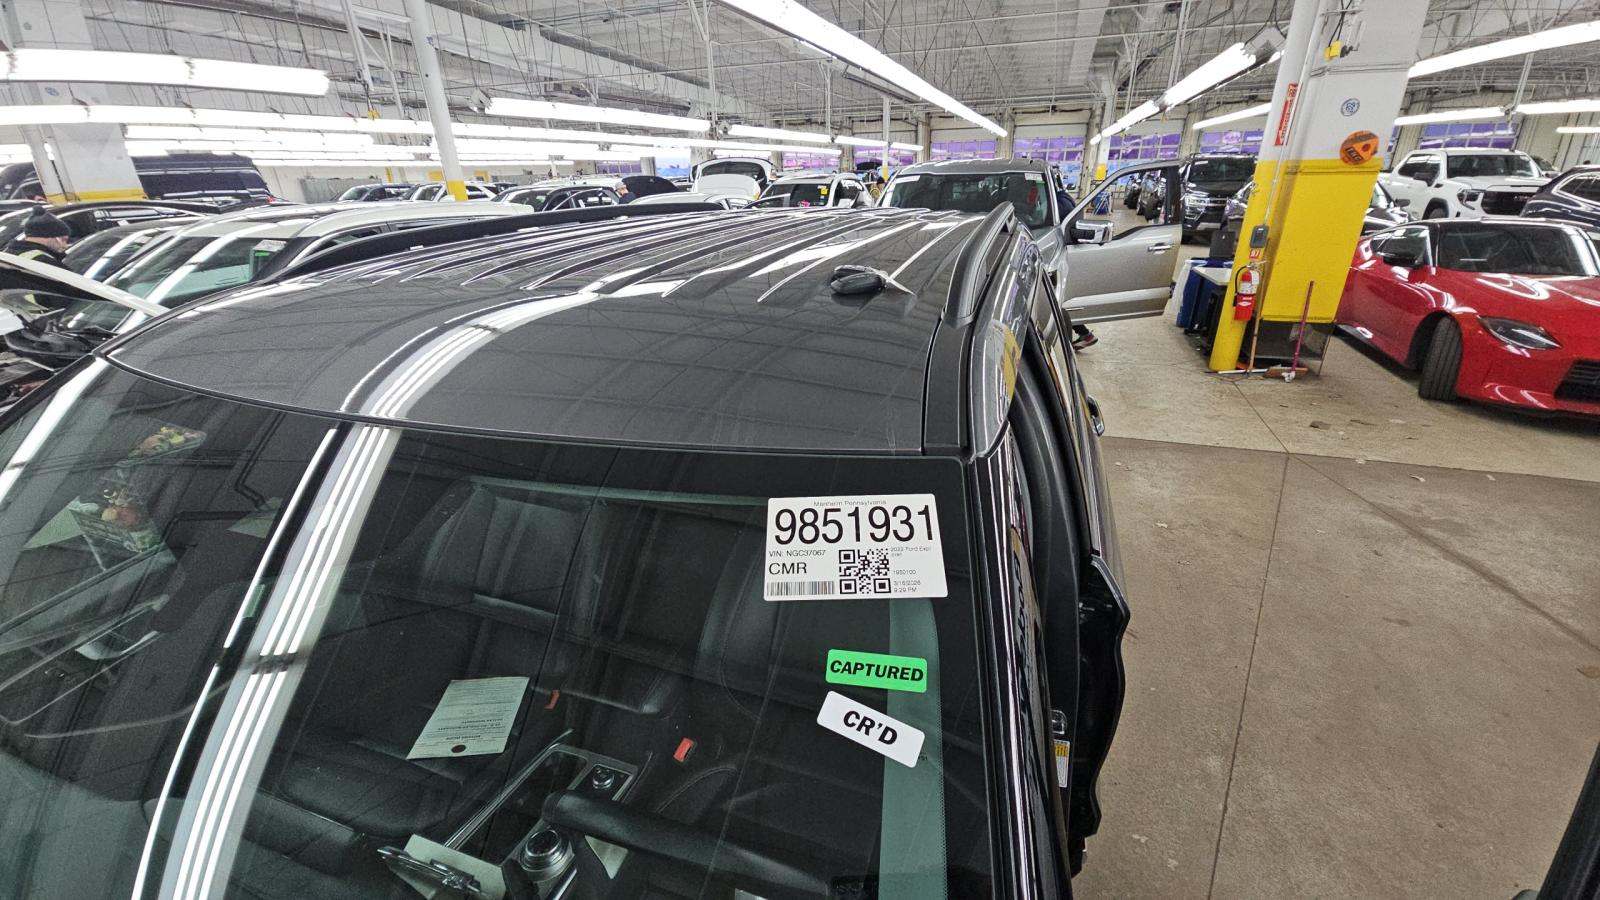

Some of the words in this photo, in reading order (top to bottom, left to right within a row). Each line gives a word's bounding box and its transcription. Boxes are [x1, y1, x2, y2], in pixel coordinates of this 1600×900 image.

[774, 505, 933, 545] 9851931
[768, 562, 807, 575] CMR
[830, 660, 924, 682] CAPTURED
